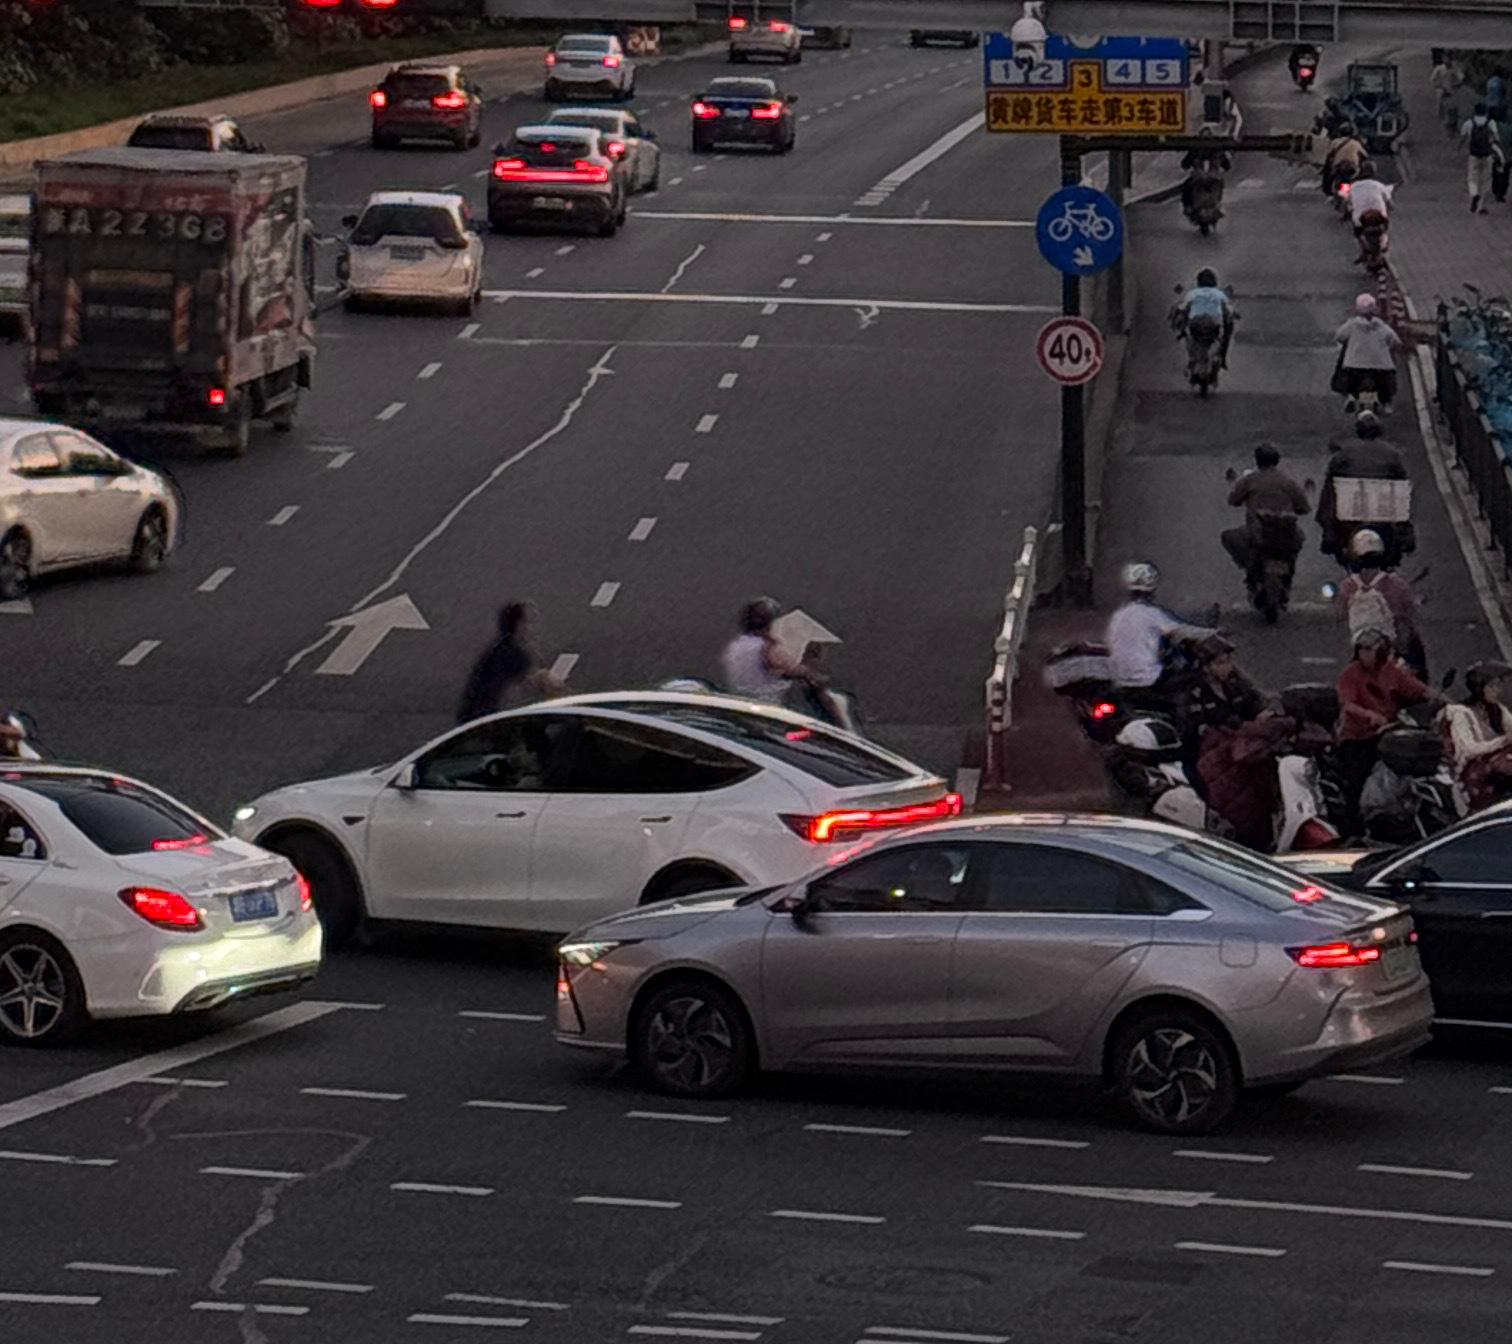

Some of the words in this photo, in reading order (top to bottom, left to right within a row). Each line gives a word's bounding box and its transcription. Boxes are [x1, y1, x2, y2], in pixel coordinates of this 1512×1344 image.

[1039, 63, 1054, 81] 2
[1077, 70, 1093, 87] 3
[1115, 62, 1131, 80] 4
[1155, 63, 1170, 80] 5
[991, 97, 1180, 126] 黄牌货车走第3车道
